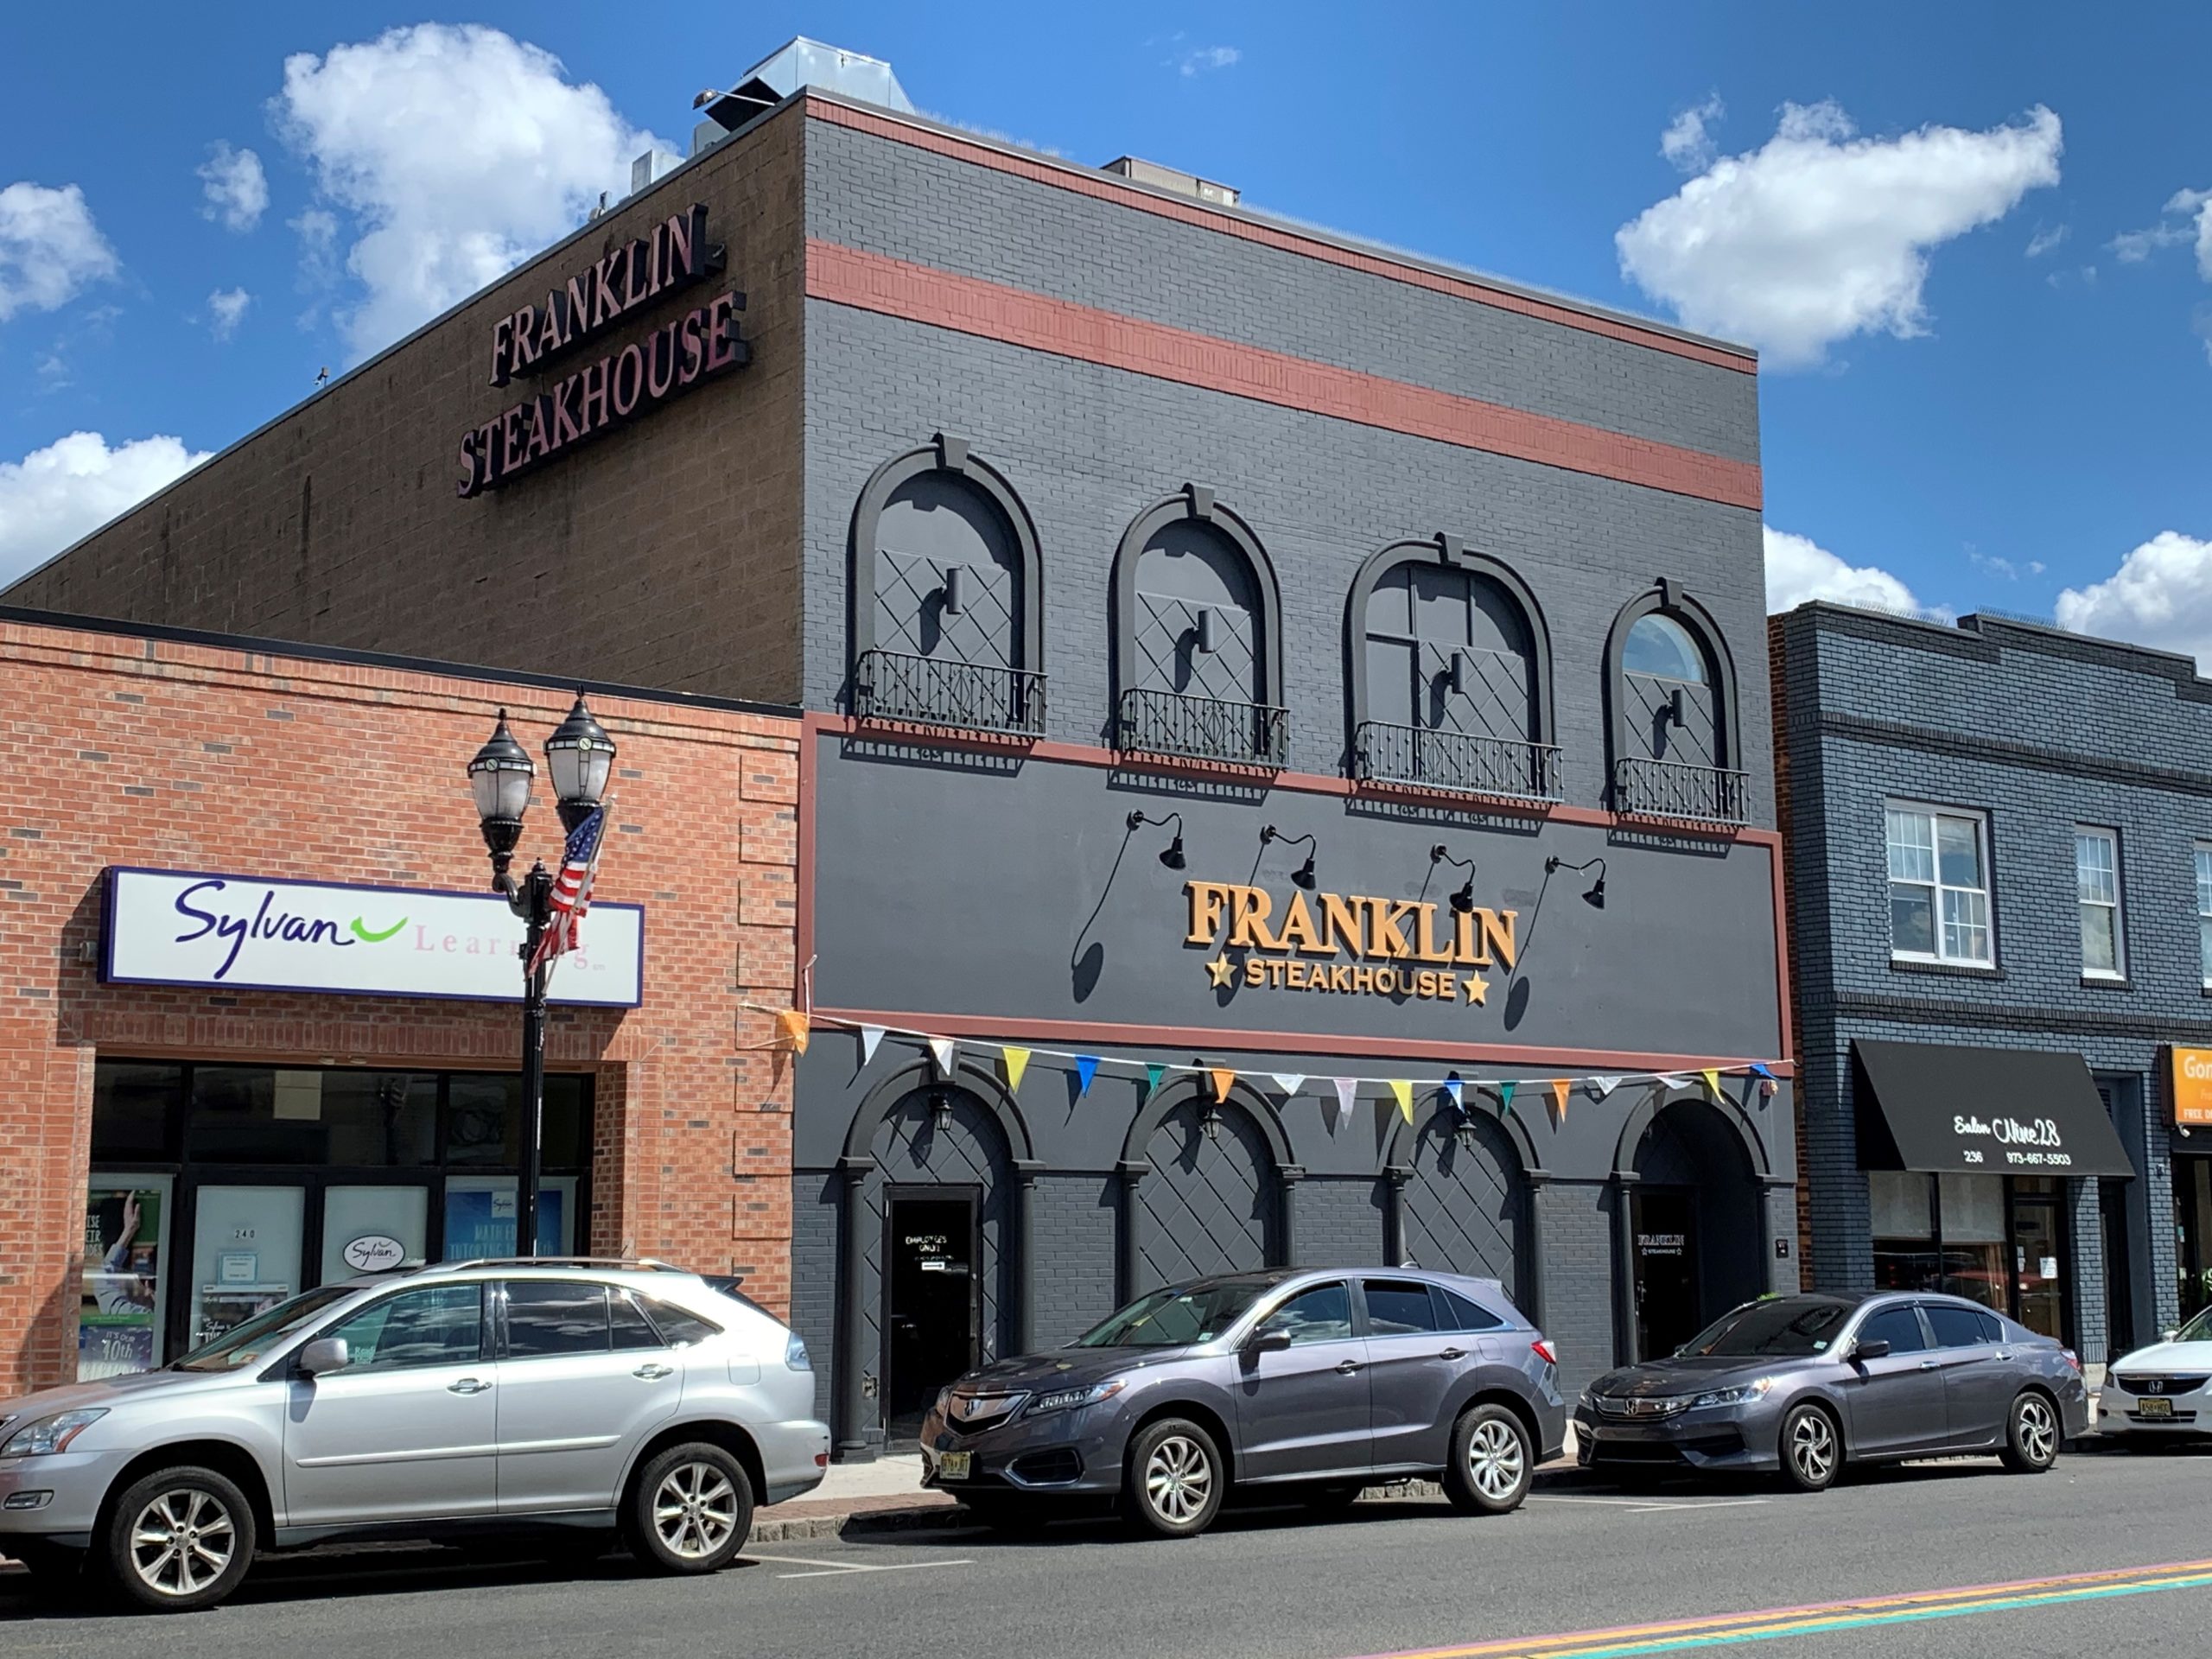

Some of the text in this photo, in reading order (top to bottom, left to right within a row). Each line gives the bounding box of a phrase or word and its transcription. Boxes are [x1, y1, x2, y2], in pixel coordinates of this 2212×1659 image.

[489, 203, 708, 386] FRANKLIN
[457, 292, 747, 498] STEAKHOUSE
[175, 880, 589, 980] Sylvan Learg
[1185, 880, 1518, 969] FRANKLIN
[1245, 958, 1457, 999] STEAKHOUSE
[1954, 1116, 1991, 1135] Salon
[1963, 1150, 2072, 1166] 236 973-667-5503
[86, 1214, 100, 1229] ISE
[86, 1229, 101, 1243] EIR
[235, 1230, 256, 1239] 240
[1637, 1234, 1685, 1246] FRANKLIN
[353, 1241, 397, 1268] Sylvan
